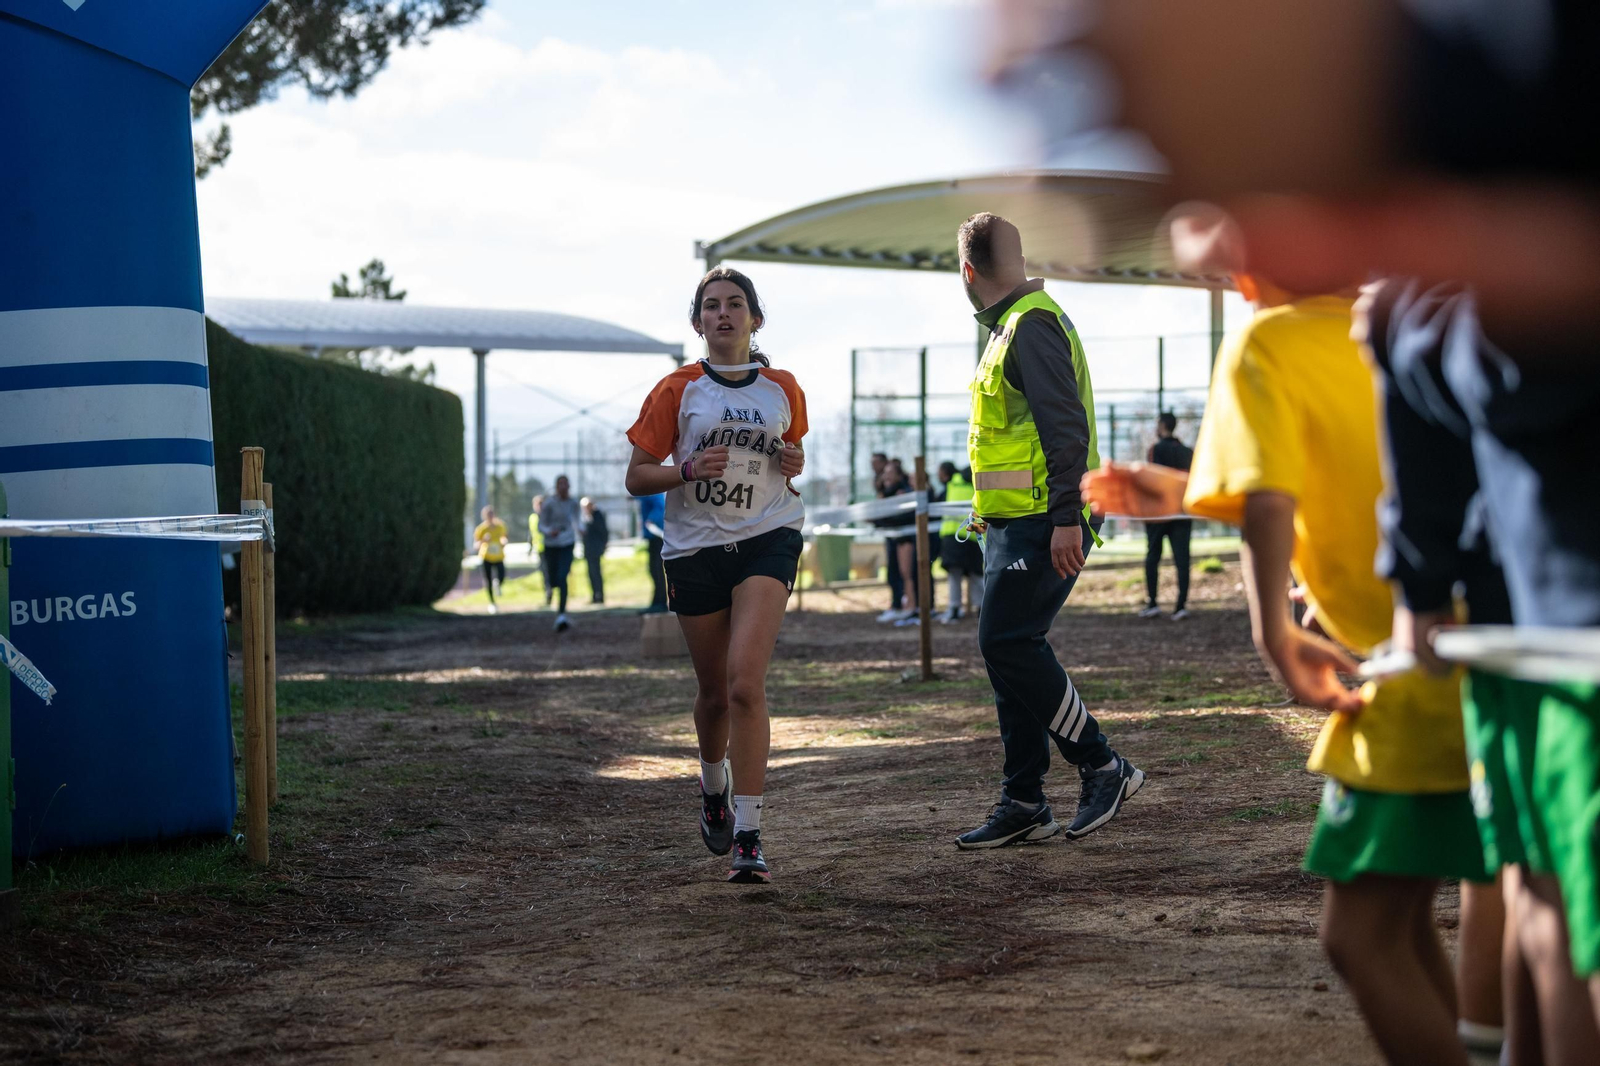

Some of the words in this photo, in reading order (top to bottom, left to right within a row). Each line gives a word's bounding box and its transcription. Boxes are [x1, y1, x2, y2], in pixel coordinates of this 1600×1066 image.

[721, 406, 766, 426] ANA
[694, 427, 780, 459] MOGAS
[695, 479, 754, 509] 0341
[10, 591, 137, 625] BURGAS
